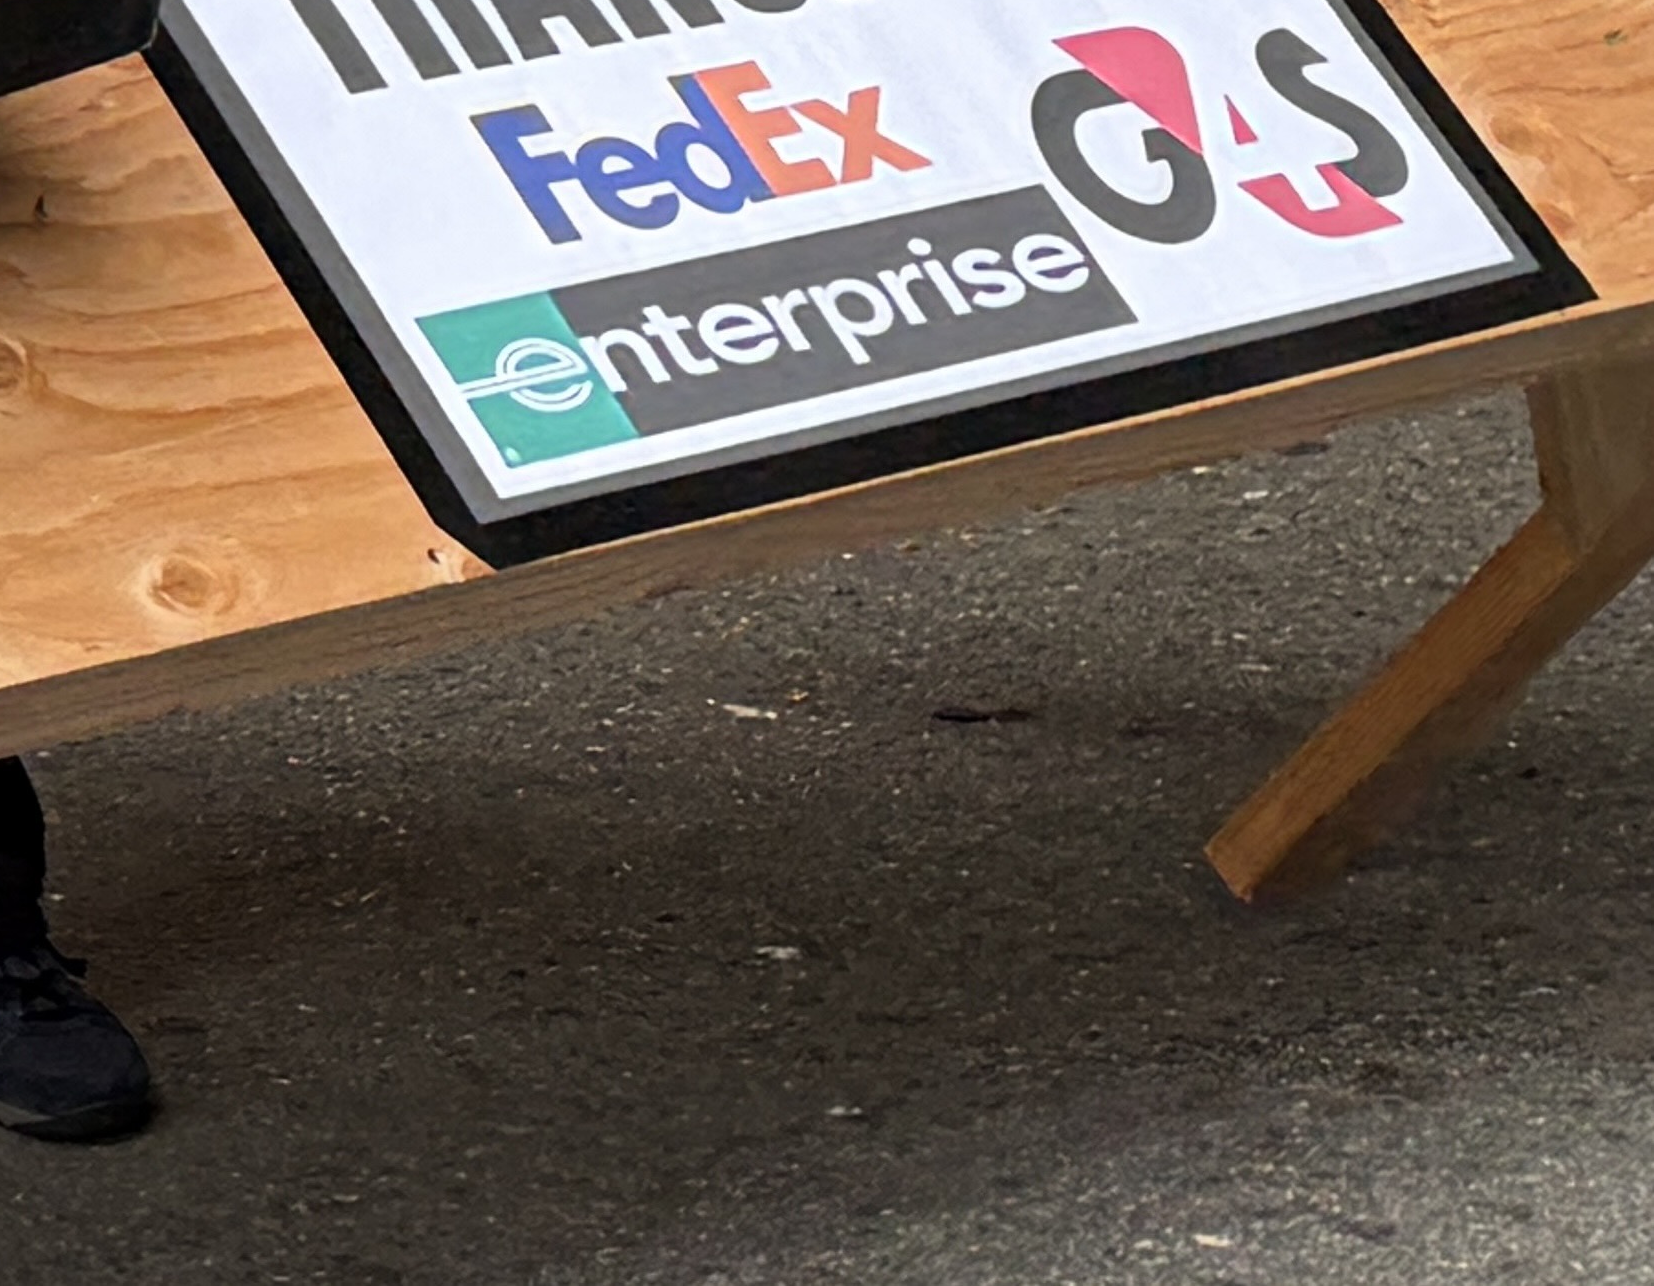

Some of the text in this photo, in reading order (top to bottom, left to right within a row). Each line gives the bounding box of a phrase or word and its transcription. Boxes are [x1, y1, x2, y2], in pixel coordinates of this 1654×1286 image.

[470, 57, 933, 246] FedEx
[1030, 25, 1410, 245] G4S
[455, 227, 1091, 419] enterprise
